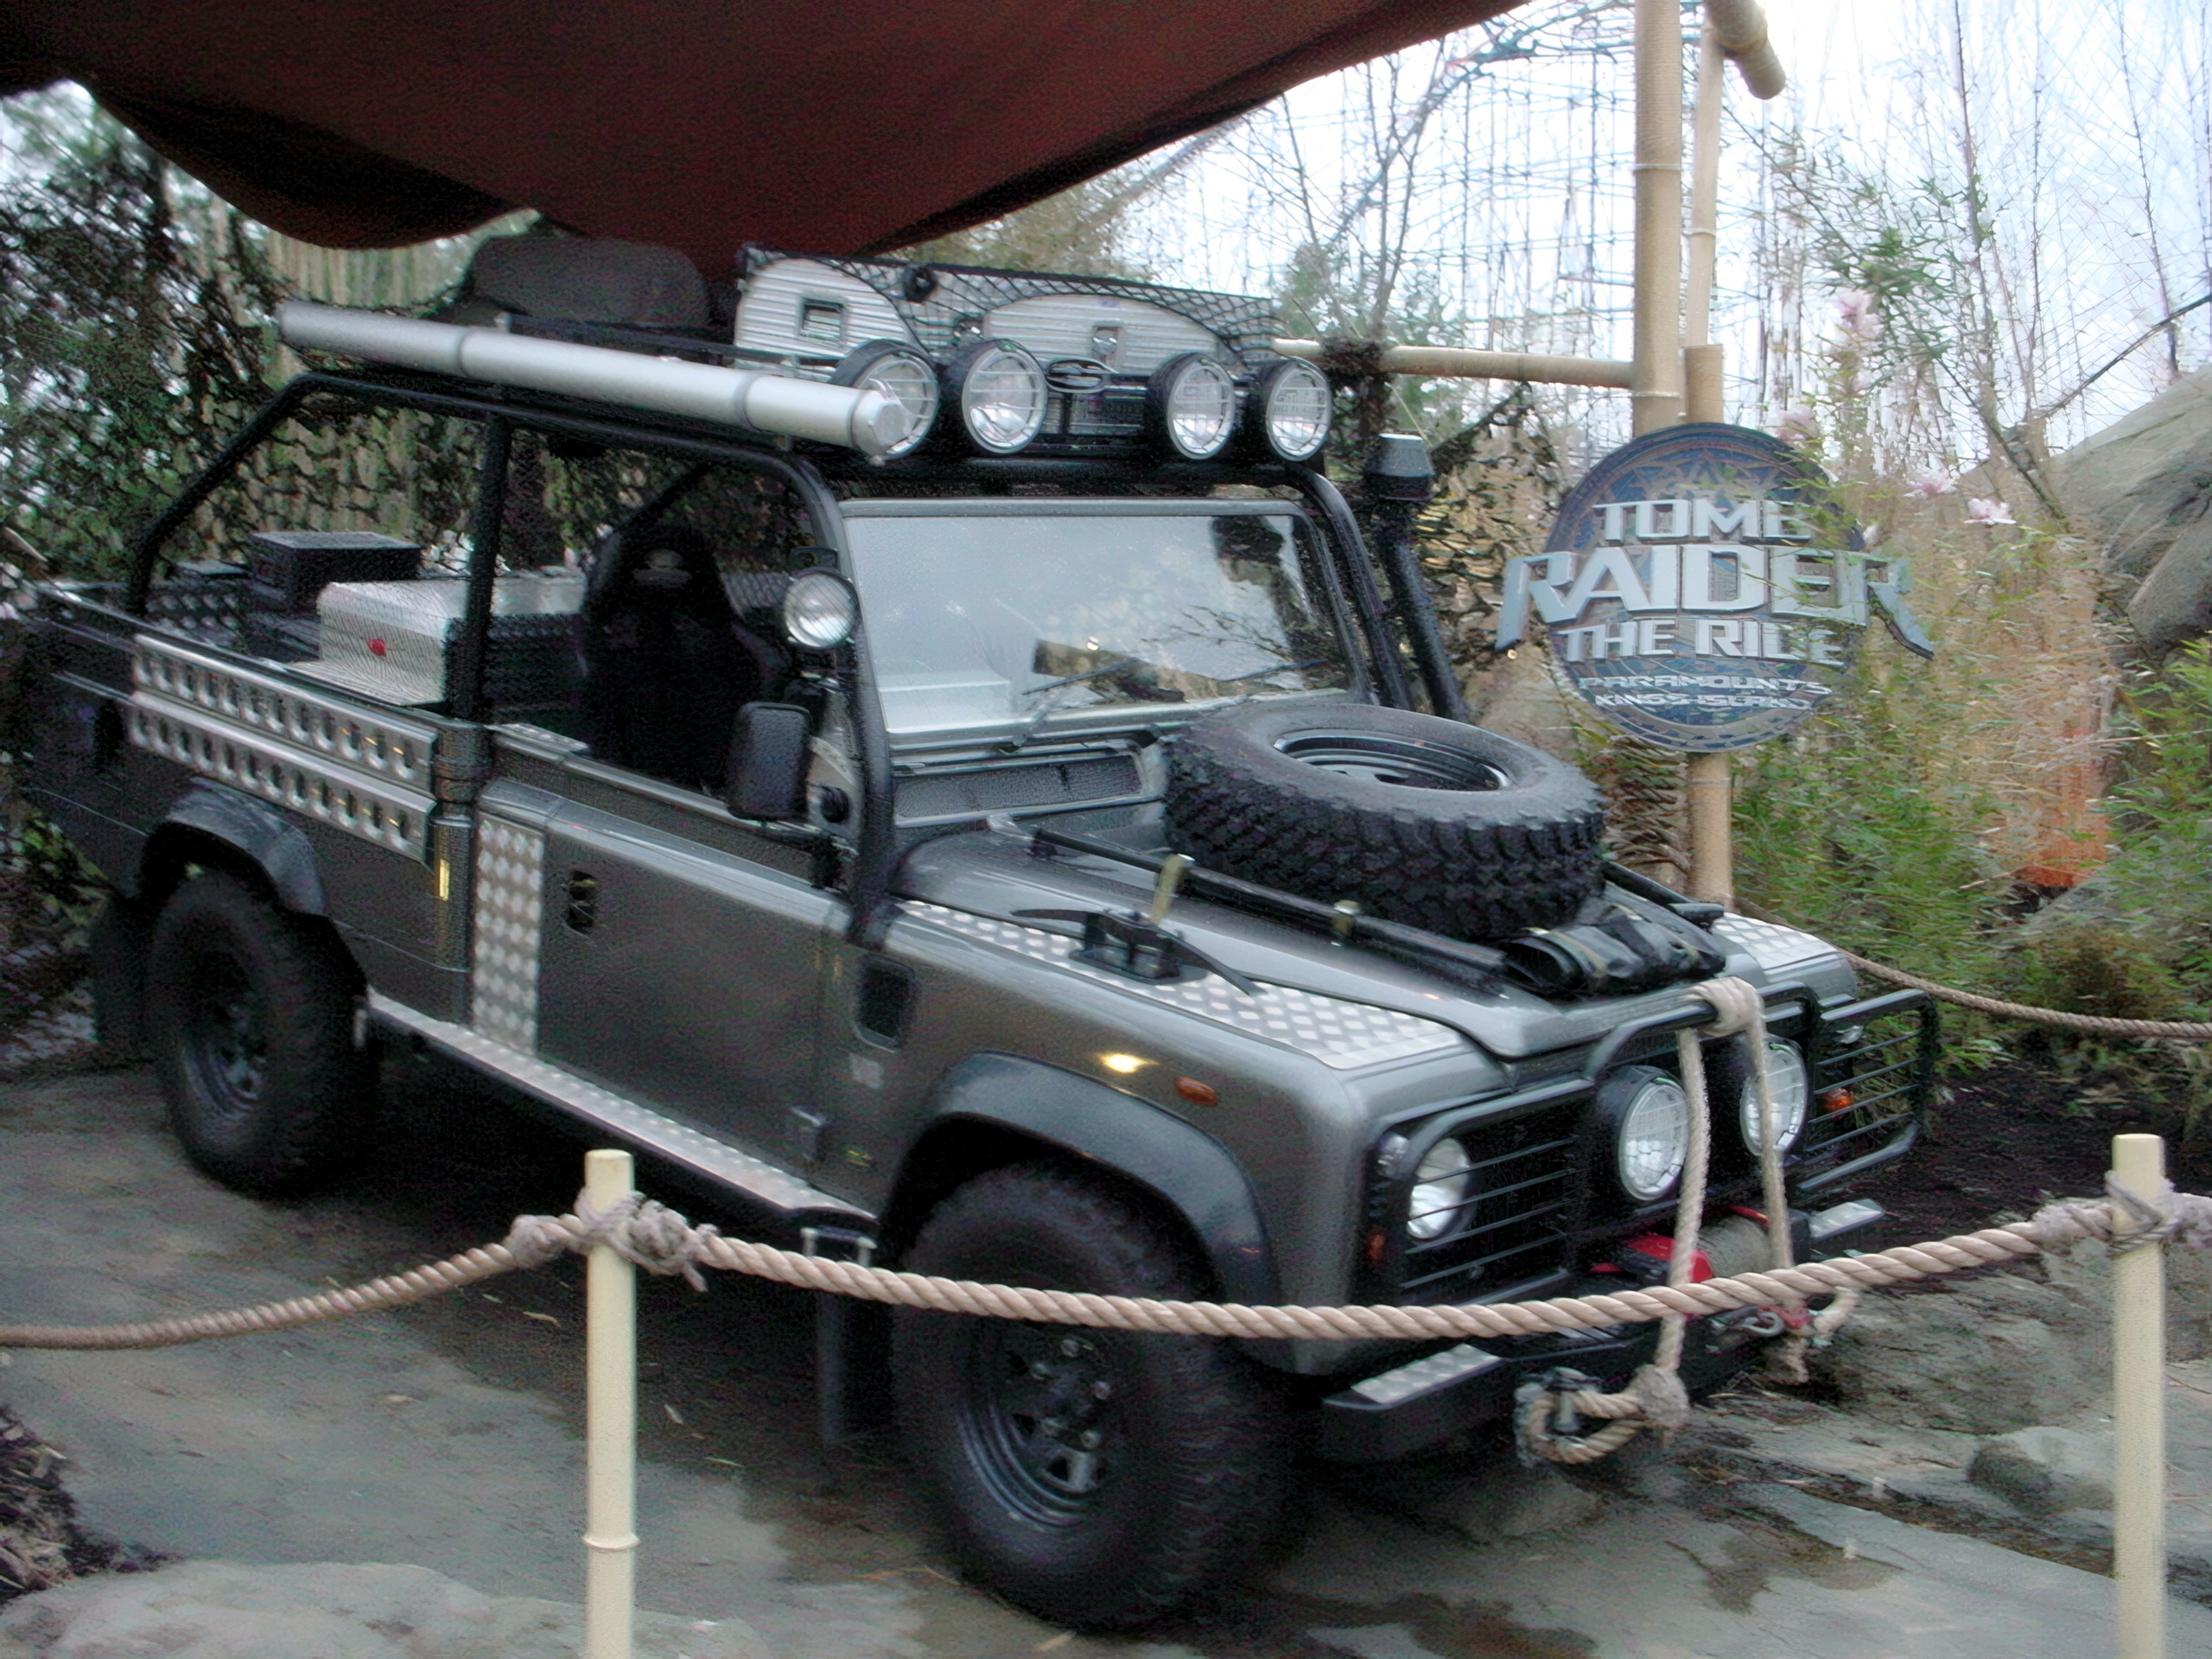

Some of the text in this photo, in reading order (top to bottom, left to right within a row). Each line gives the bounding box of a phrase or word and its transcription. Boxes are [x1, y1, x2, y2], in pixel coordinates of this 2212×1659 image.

[1592, 499, 1812, 543] TOMB
[1494, 543, 1935, 661] RAIDER
[1556, 619, 1847, 669] THE RIDE
